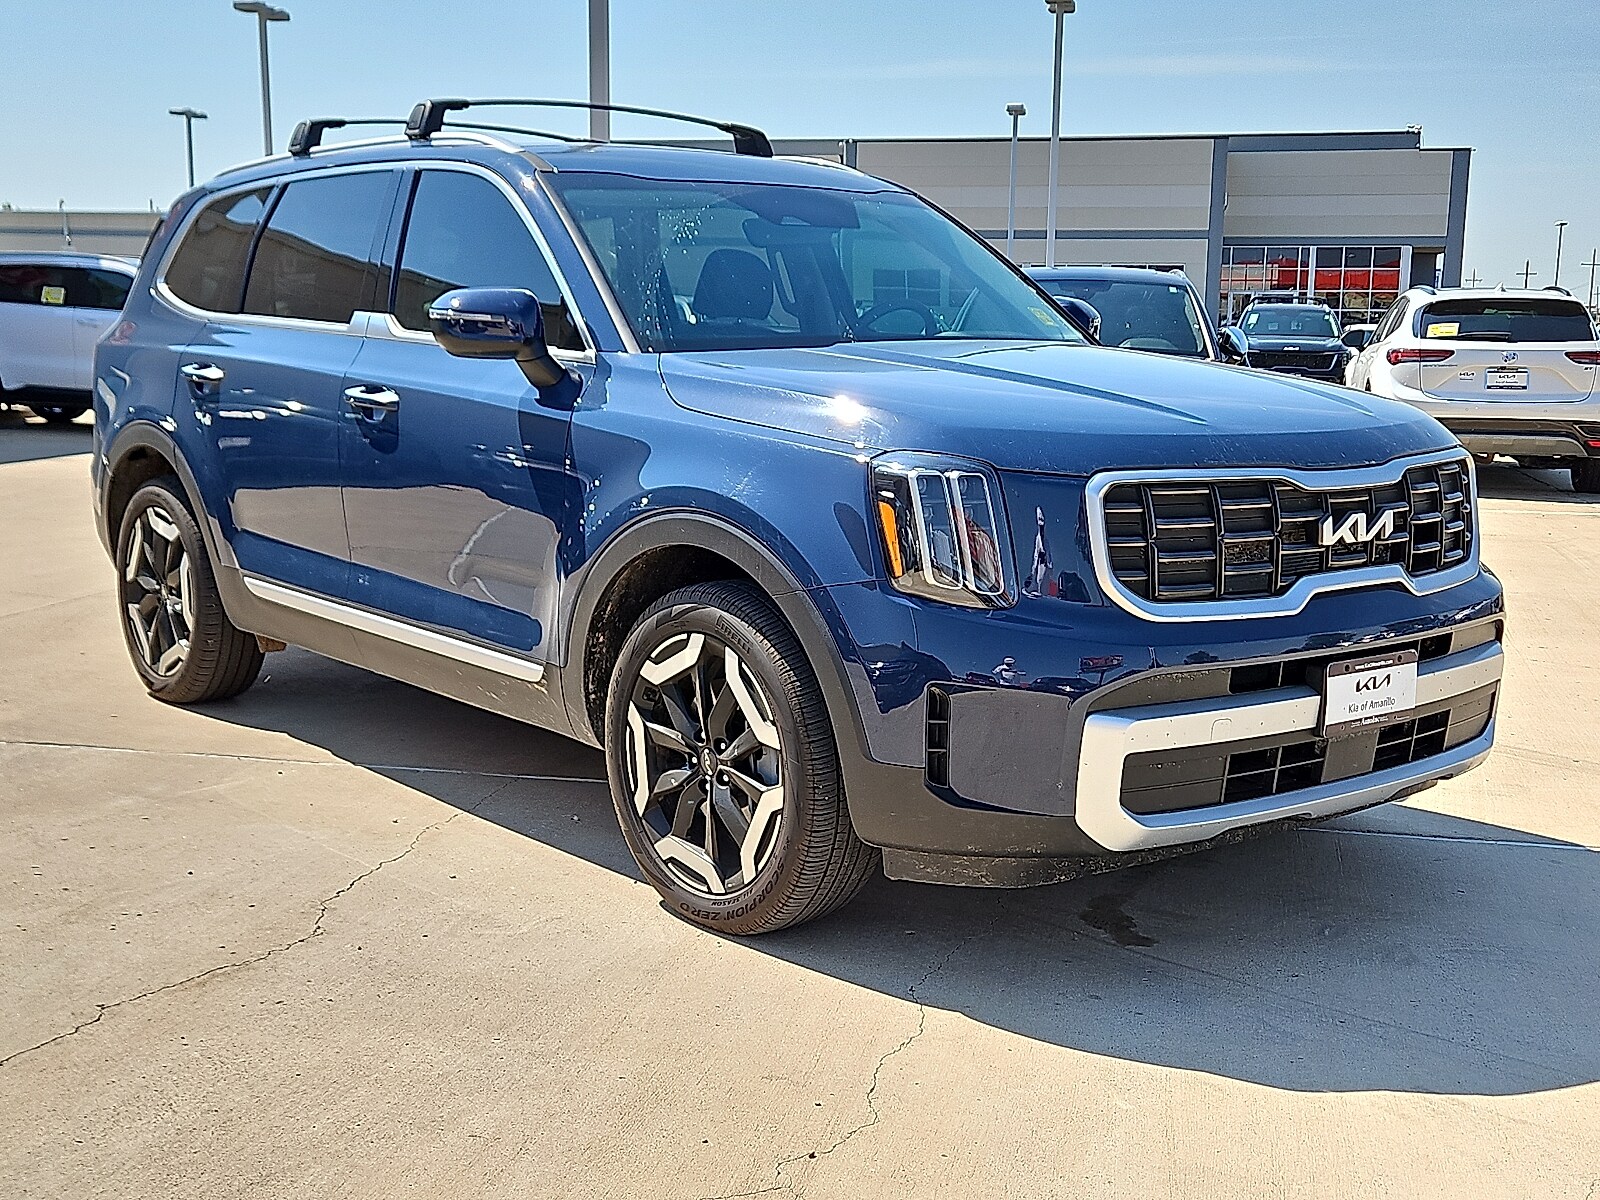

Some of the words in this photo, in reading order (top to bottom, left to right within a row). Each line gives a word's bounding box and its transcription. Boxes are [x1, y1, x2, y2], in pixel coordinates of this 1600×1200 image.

[1320, 509, 1394, 545] KIA
[1355, 673, 1391, 693] KIA
[1348, 703, 1359, 714] Kia
[1360, 700, 1369, 711] of
[1369, 696, 1396, 709] Amarillo
[725, 857, 785, 921] SCORPION
[680, 902, 721, 920] ZERO
[711, 897, 741, 907] SEASON
